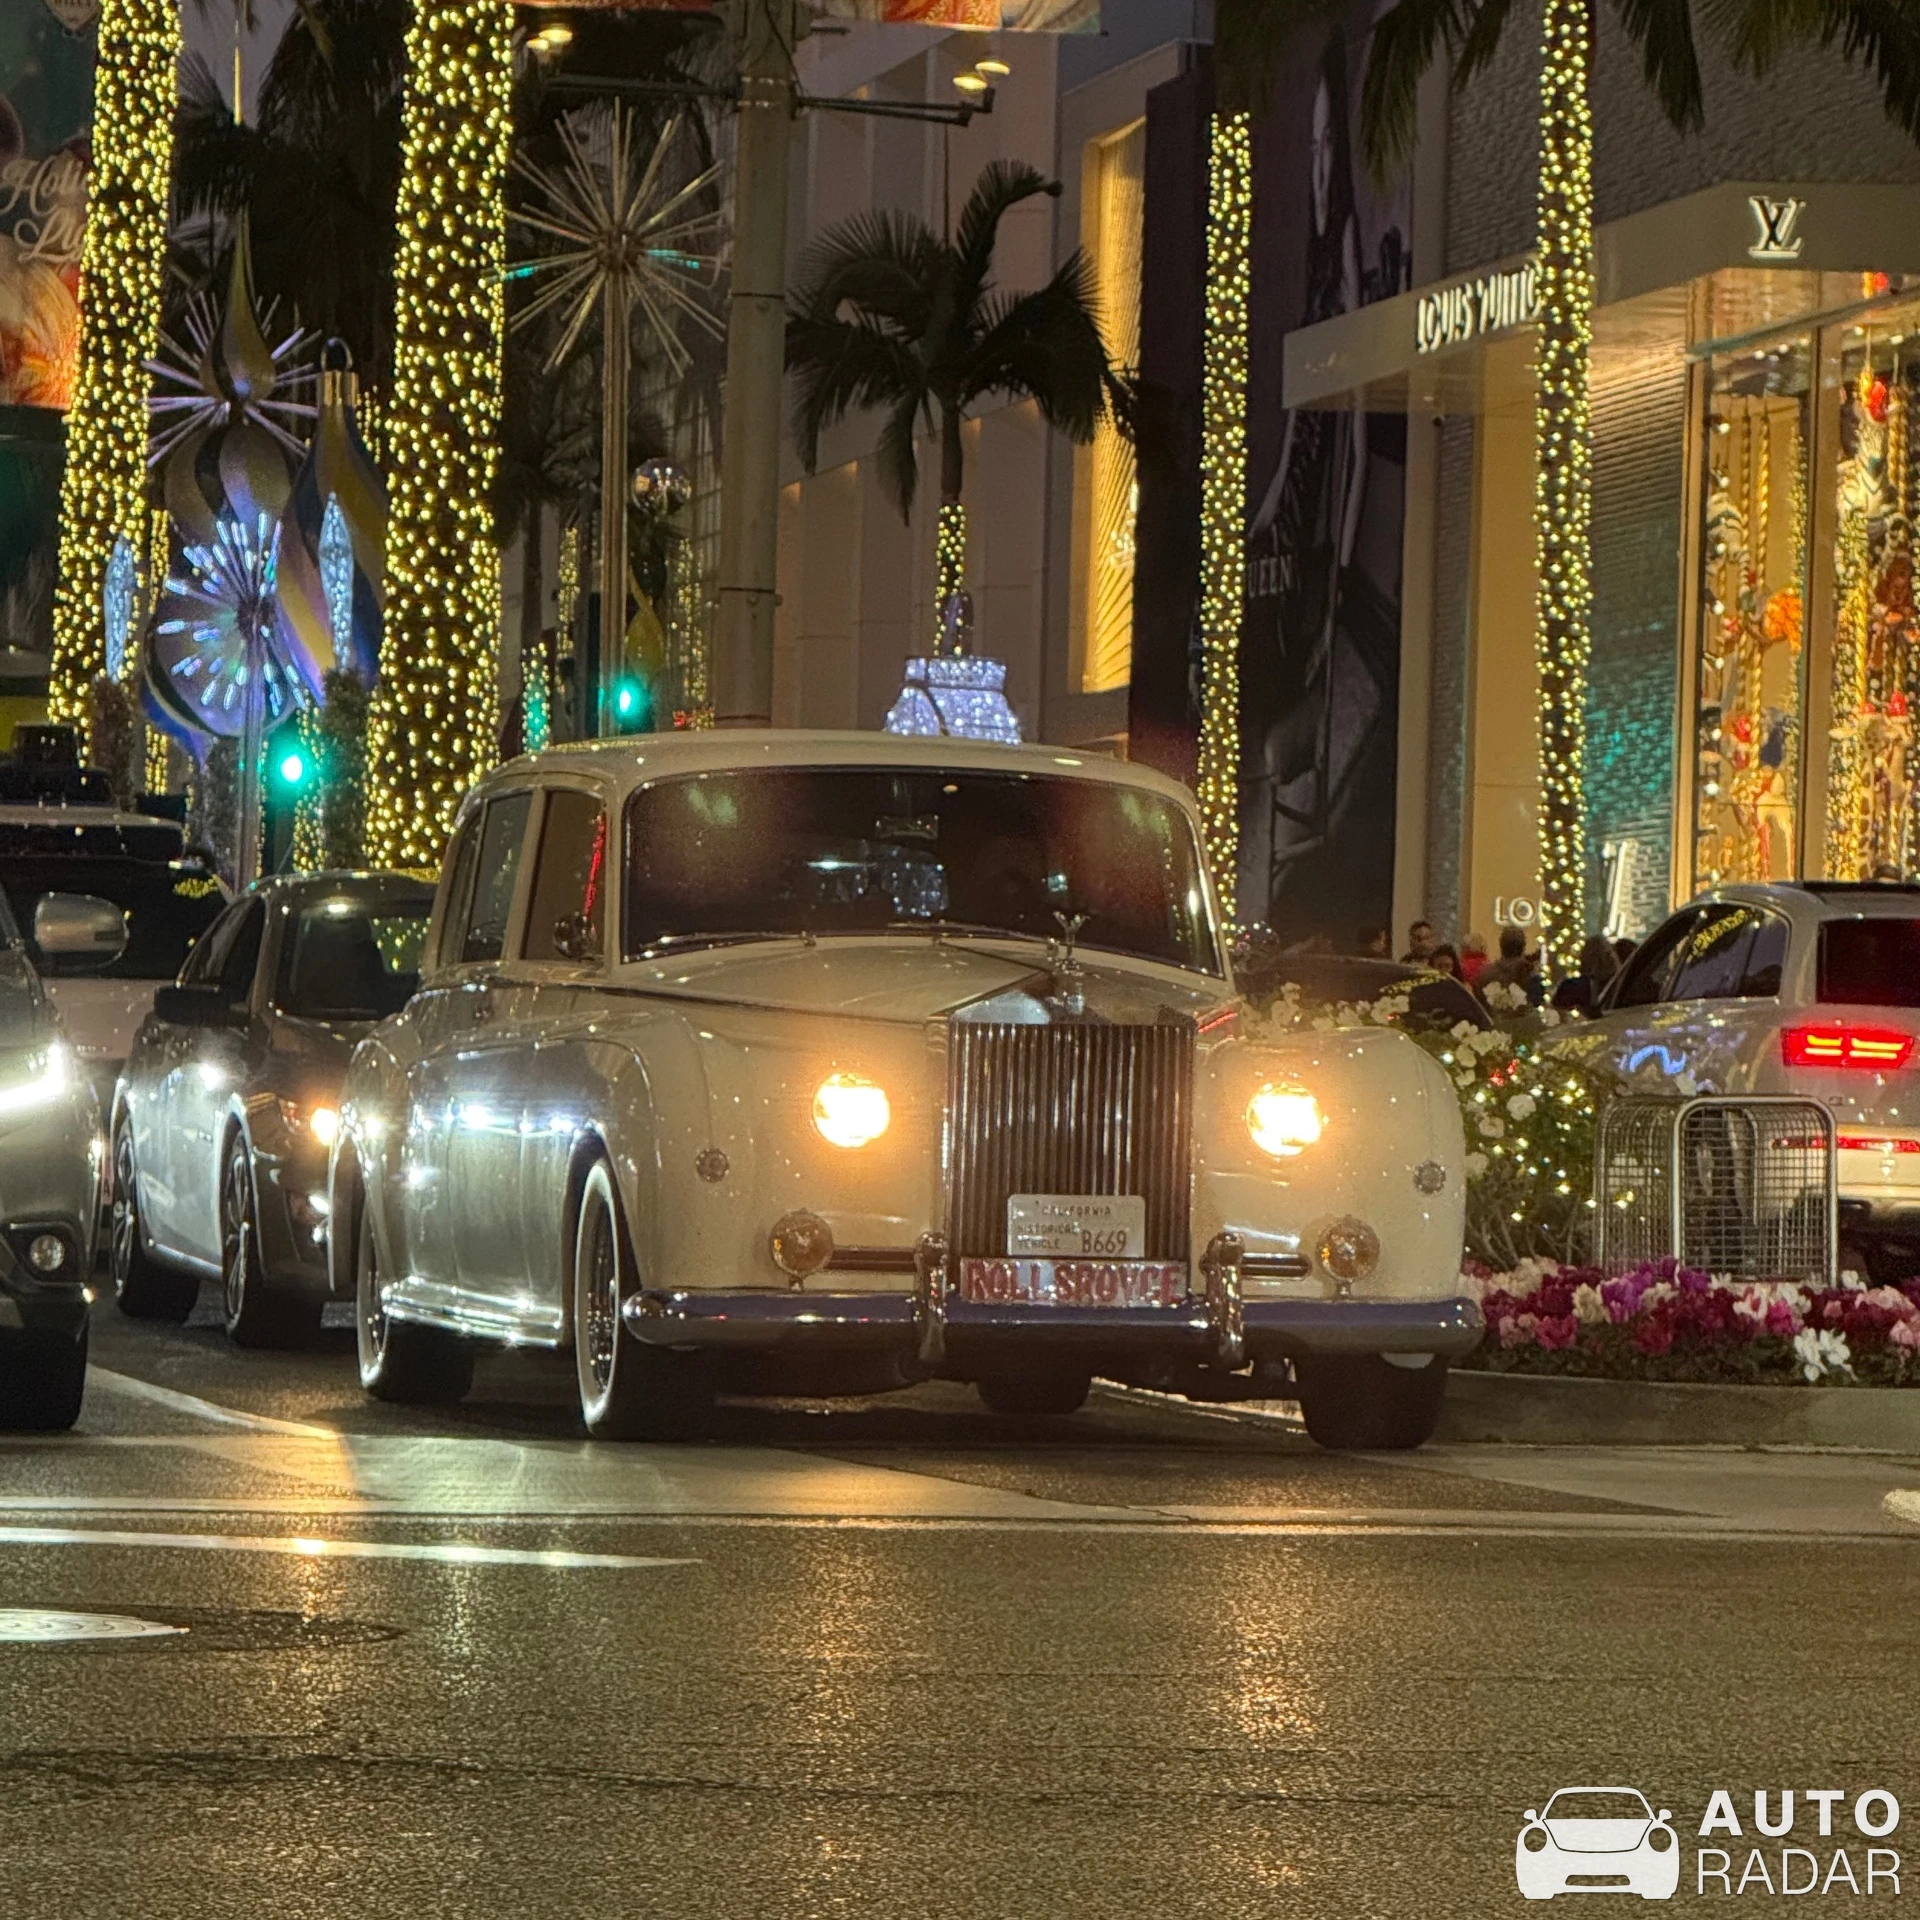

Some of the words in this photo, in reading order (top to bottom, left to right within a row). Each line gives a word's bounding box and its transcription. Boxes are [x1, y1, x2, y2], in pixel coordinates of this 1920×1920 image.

[1417, 282, 1473, 355] LOUIS
[1476, 257, 1546, 335] VUITTO
[1043, 1204, 1111, 1218] CALIFORNIA
[1081, 1229, 1127, 1254] B669
